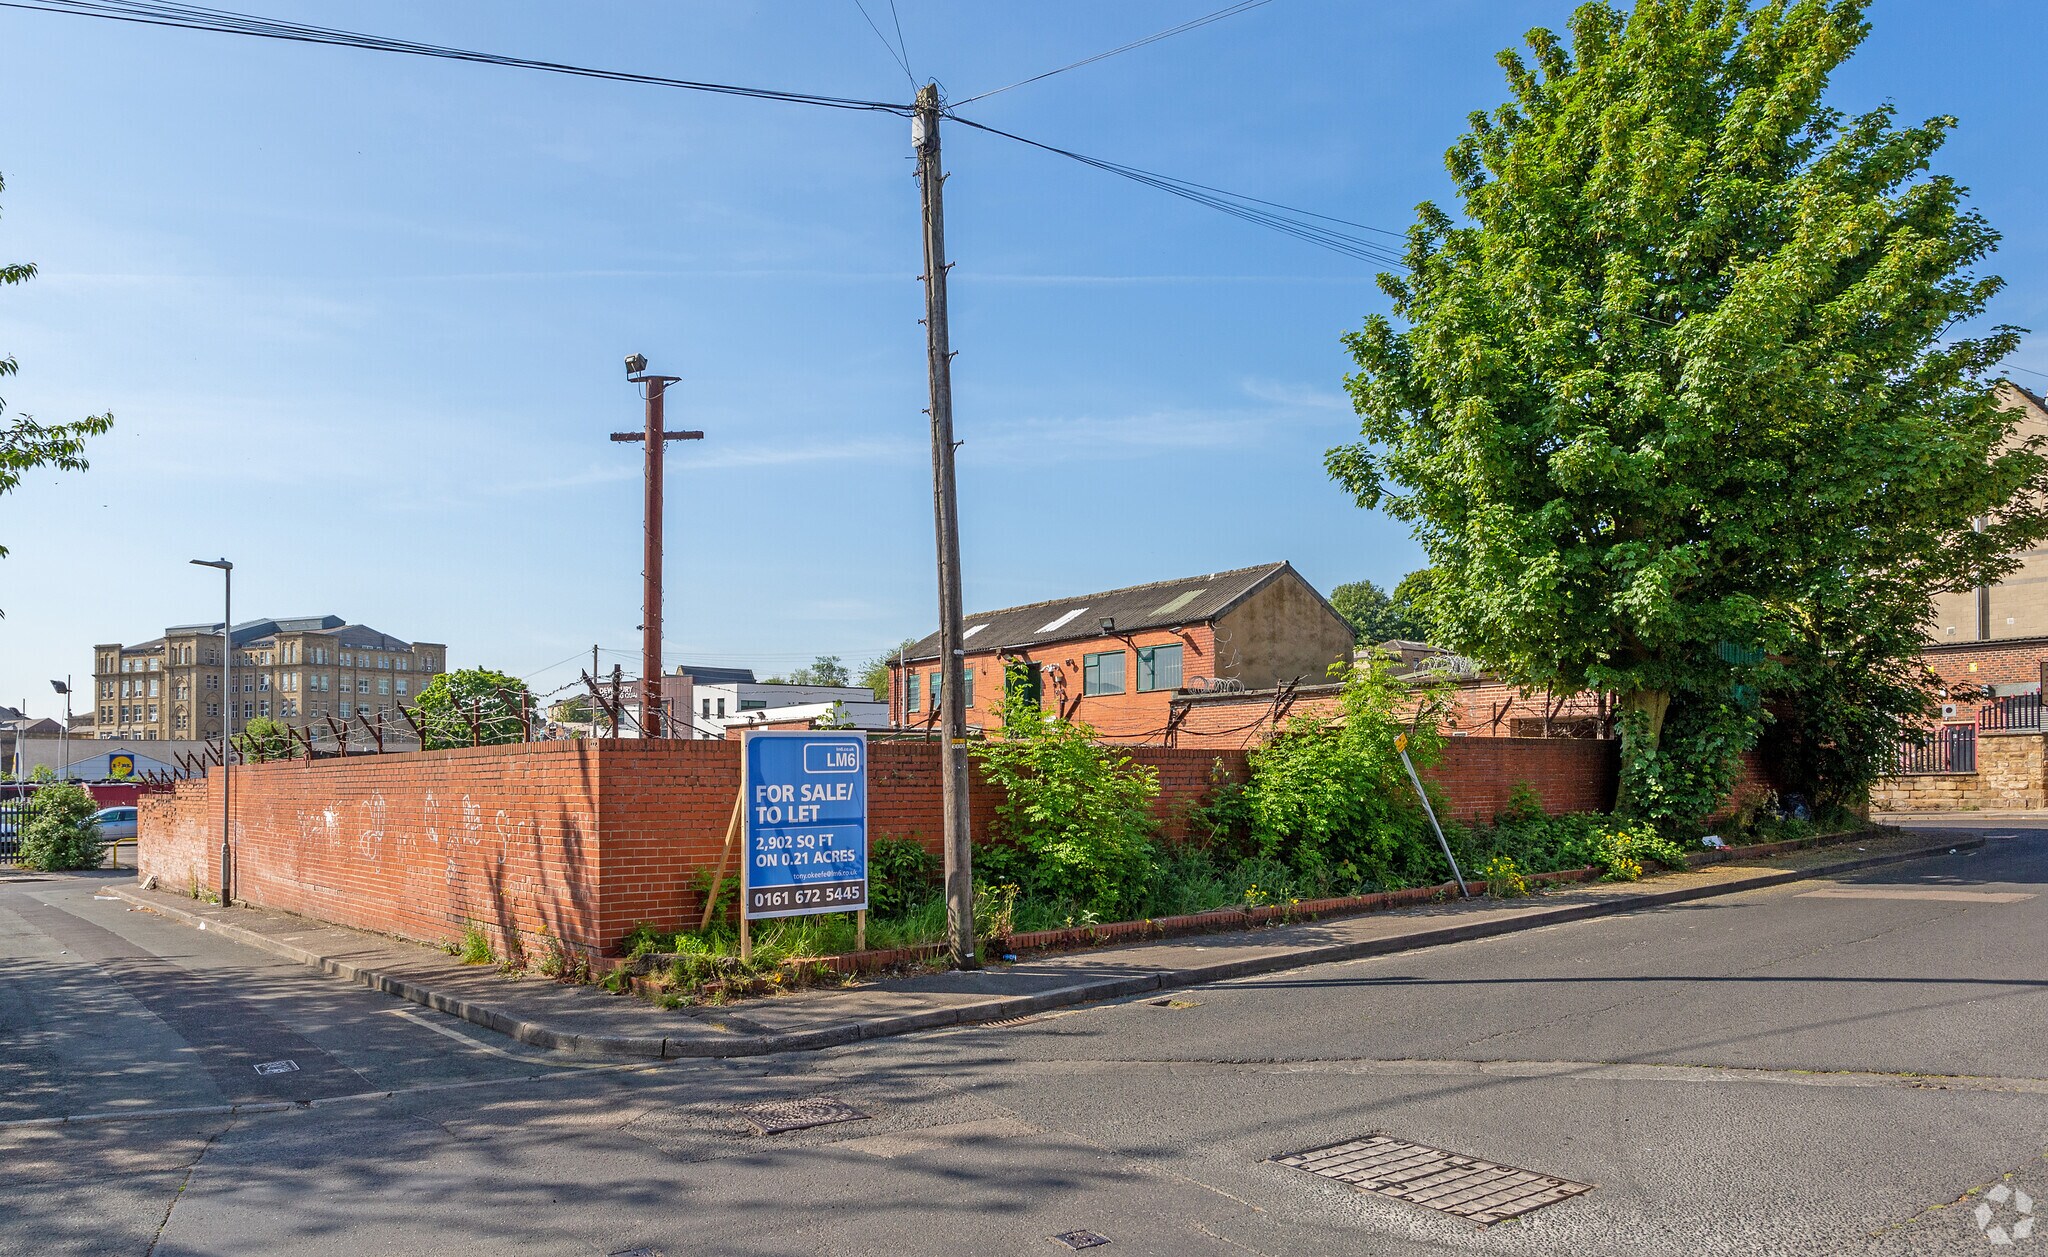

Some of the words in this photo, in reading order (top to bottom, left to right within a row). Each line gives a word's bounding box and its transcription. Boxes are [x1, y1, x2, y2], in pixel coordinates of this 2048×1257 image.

[827, 752, 856, 767] LM6
[756, 784, 795, 803] FOR
[800, 782, 854, 802] SALE/
[755, 806, 782, 825] TO
[788, 804, 821, 823] LET
[756, 835, 793, 851] 2,902
[796, 834, 815, 849] SQ
[819, 833, 834, 847] FT
[756, 854, 778, 868] ON
[781, 852, 809, 866] 0.21
[813, 849, 856, 864] ACRES
[754, 891, 789, 907] 0161
[795, 889, 821, 904] 672
[825, 886, 860, 901] 5445
